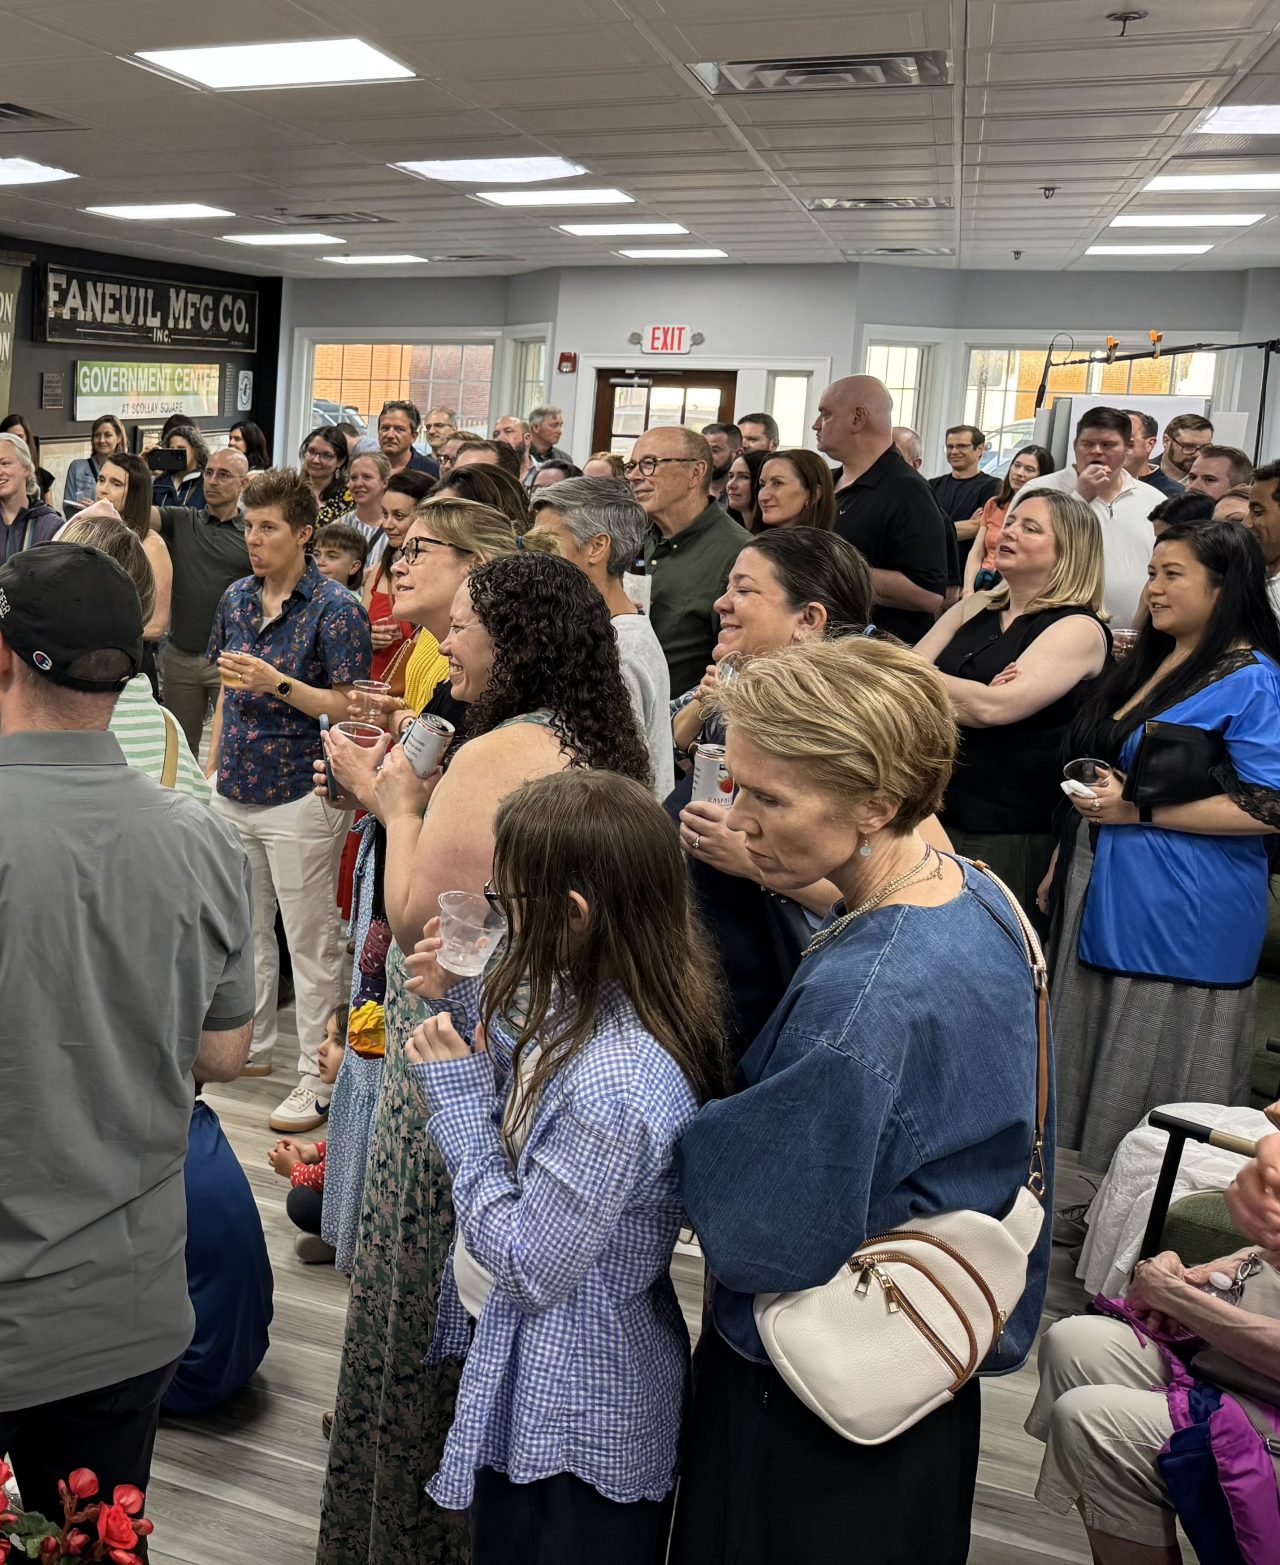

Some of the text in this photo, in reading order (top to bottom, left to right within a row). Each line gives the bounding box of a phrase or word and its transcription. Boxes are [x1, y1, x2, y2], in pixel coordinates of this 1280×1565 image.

[48, 272, 250, 335] FANEUIL MFG CO.
[152, 328, 172, 343] INC.
[650, 326, 685, 351] EXIT
[79, 366, 172, 393] GOVERNMENT
[121, 401, 183, 414] AT SCOLLAY SQUARE
